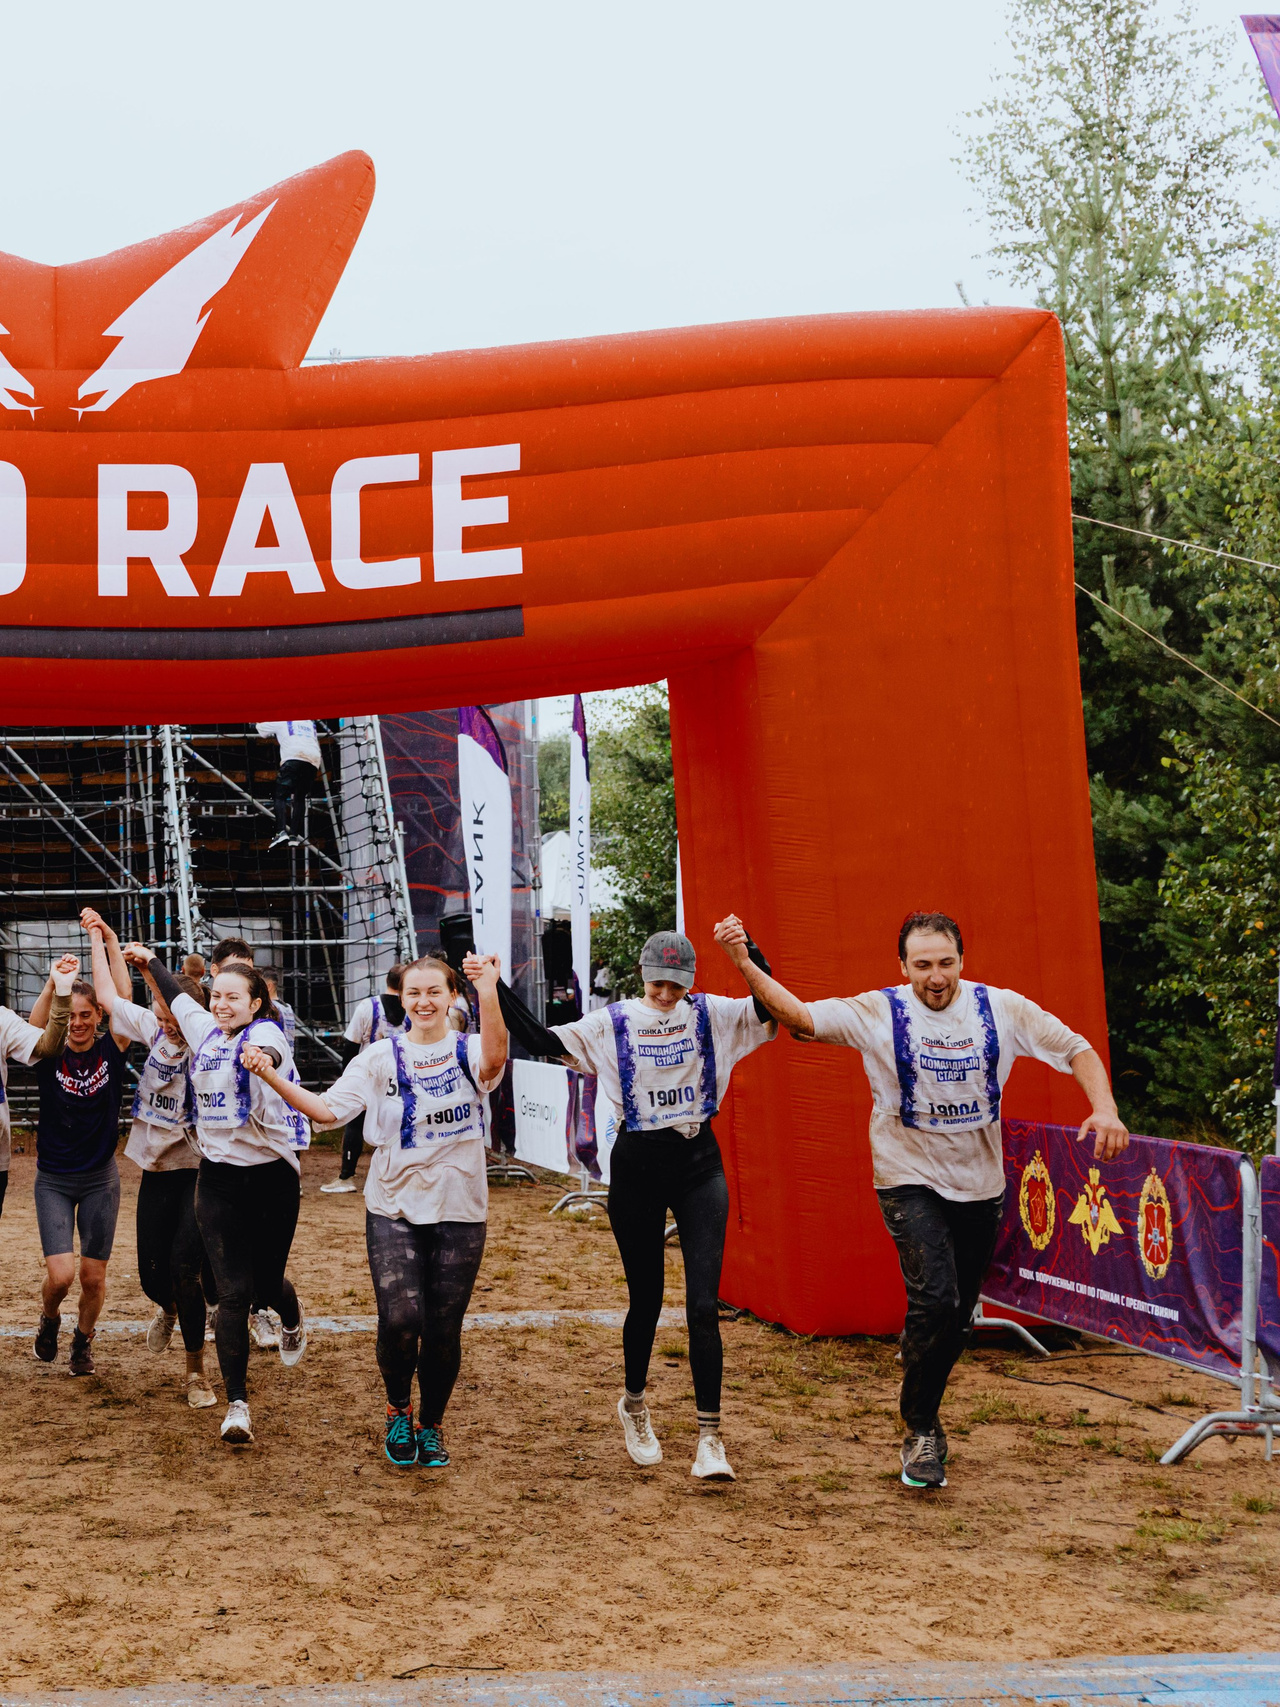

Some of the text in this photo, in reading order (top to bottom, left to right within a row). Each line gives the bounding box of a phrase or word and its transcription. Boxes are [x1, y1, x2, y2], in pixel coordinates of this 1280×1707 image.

[98, 443, 523, 597] RACE
[639, 1039, 693, 1056] КОМАНДНЫЙ
[921, 1036, 945, 1047] ГОНКА
[656, 1054, 682, 1066] СТАРТ
[921, 1056, 979, 1070] КОМАНДНЫЙ
[937, 1071, 965, 1081] СТАРТ
[648, 1086, 695, 1107] 19010
[426, 1103, 470, 1125] 19008
[1087, 1285, 1096, 1298] ПО
[1096, 1288, 1121, 1305] ГОНКАМ
[1121, 1295, 1125, 1307] С
